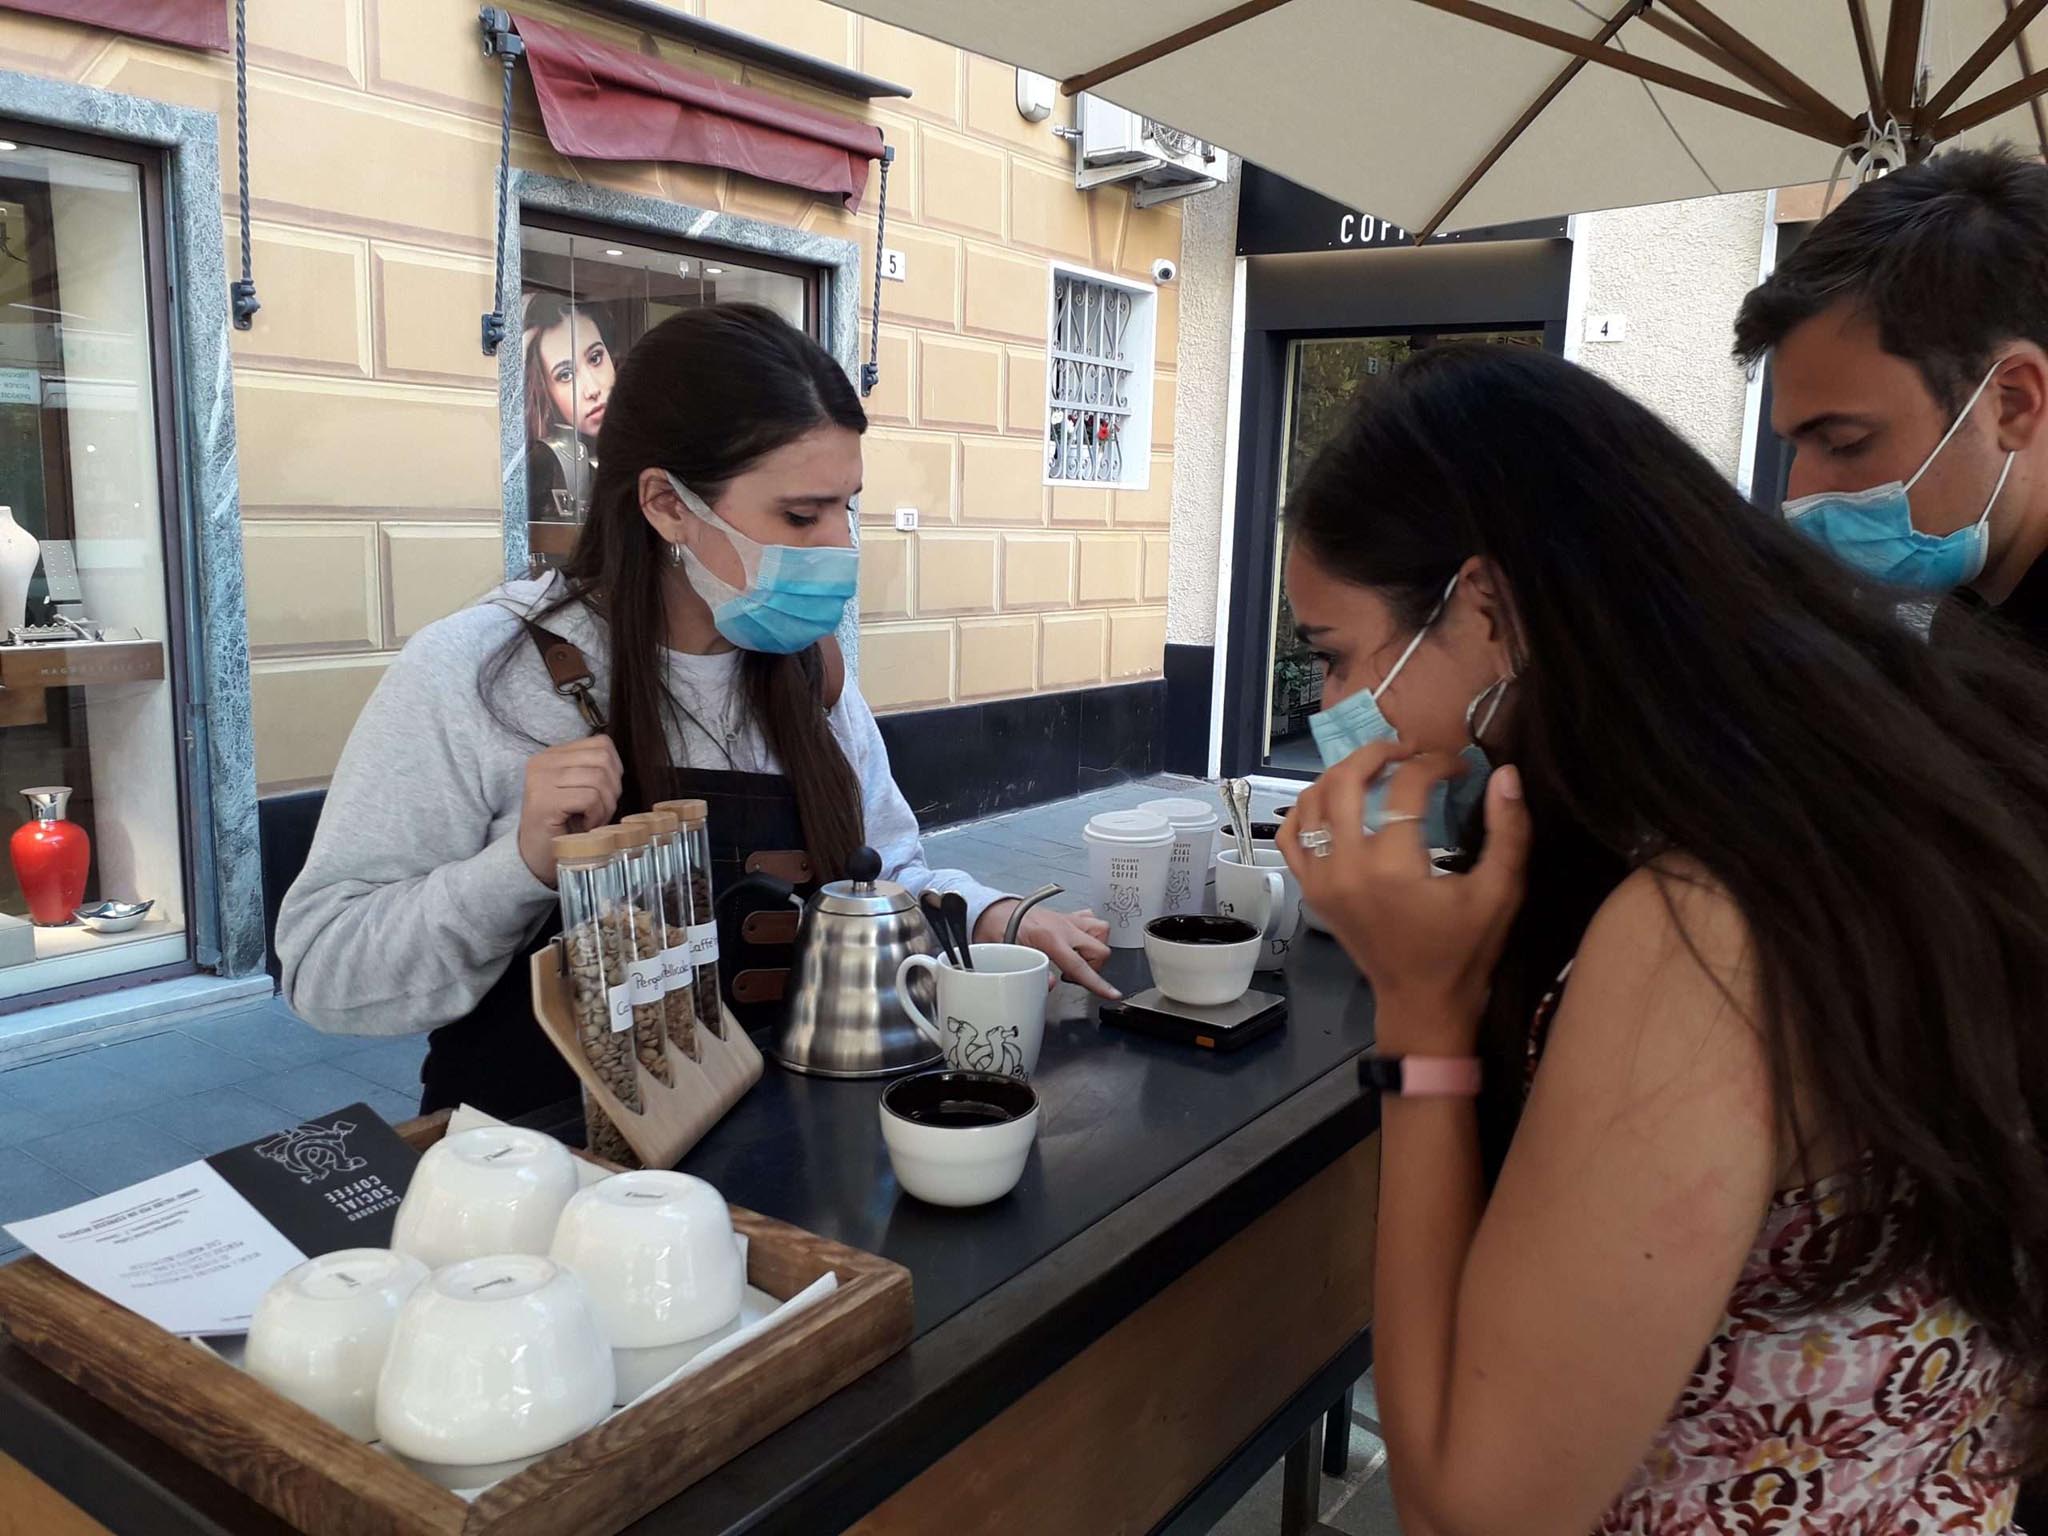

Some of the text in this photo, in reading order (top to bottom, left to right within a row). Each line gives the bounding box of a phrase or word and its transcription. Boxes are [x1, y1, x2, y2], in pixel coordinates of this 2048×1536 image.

[889, 254, 897, 274] 5
[1600, 320, 1609, 337] 4
[1173, 848, 1190, 856] CIAL
[1111, 863, 1139, 871] SOCIAL
[1111, 871, 1138, 879] COFFEE
[323, 1174, 382, 1204] COFFEE
[335, 1184, 393, 1213] SOCIAL
[347, 1195, 402, 1222] COSTADORO
